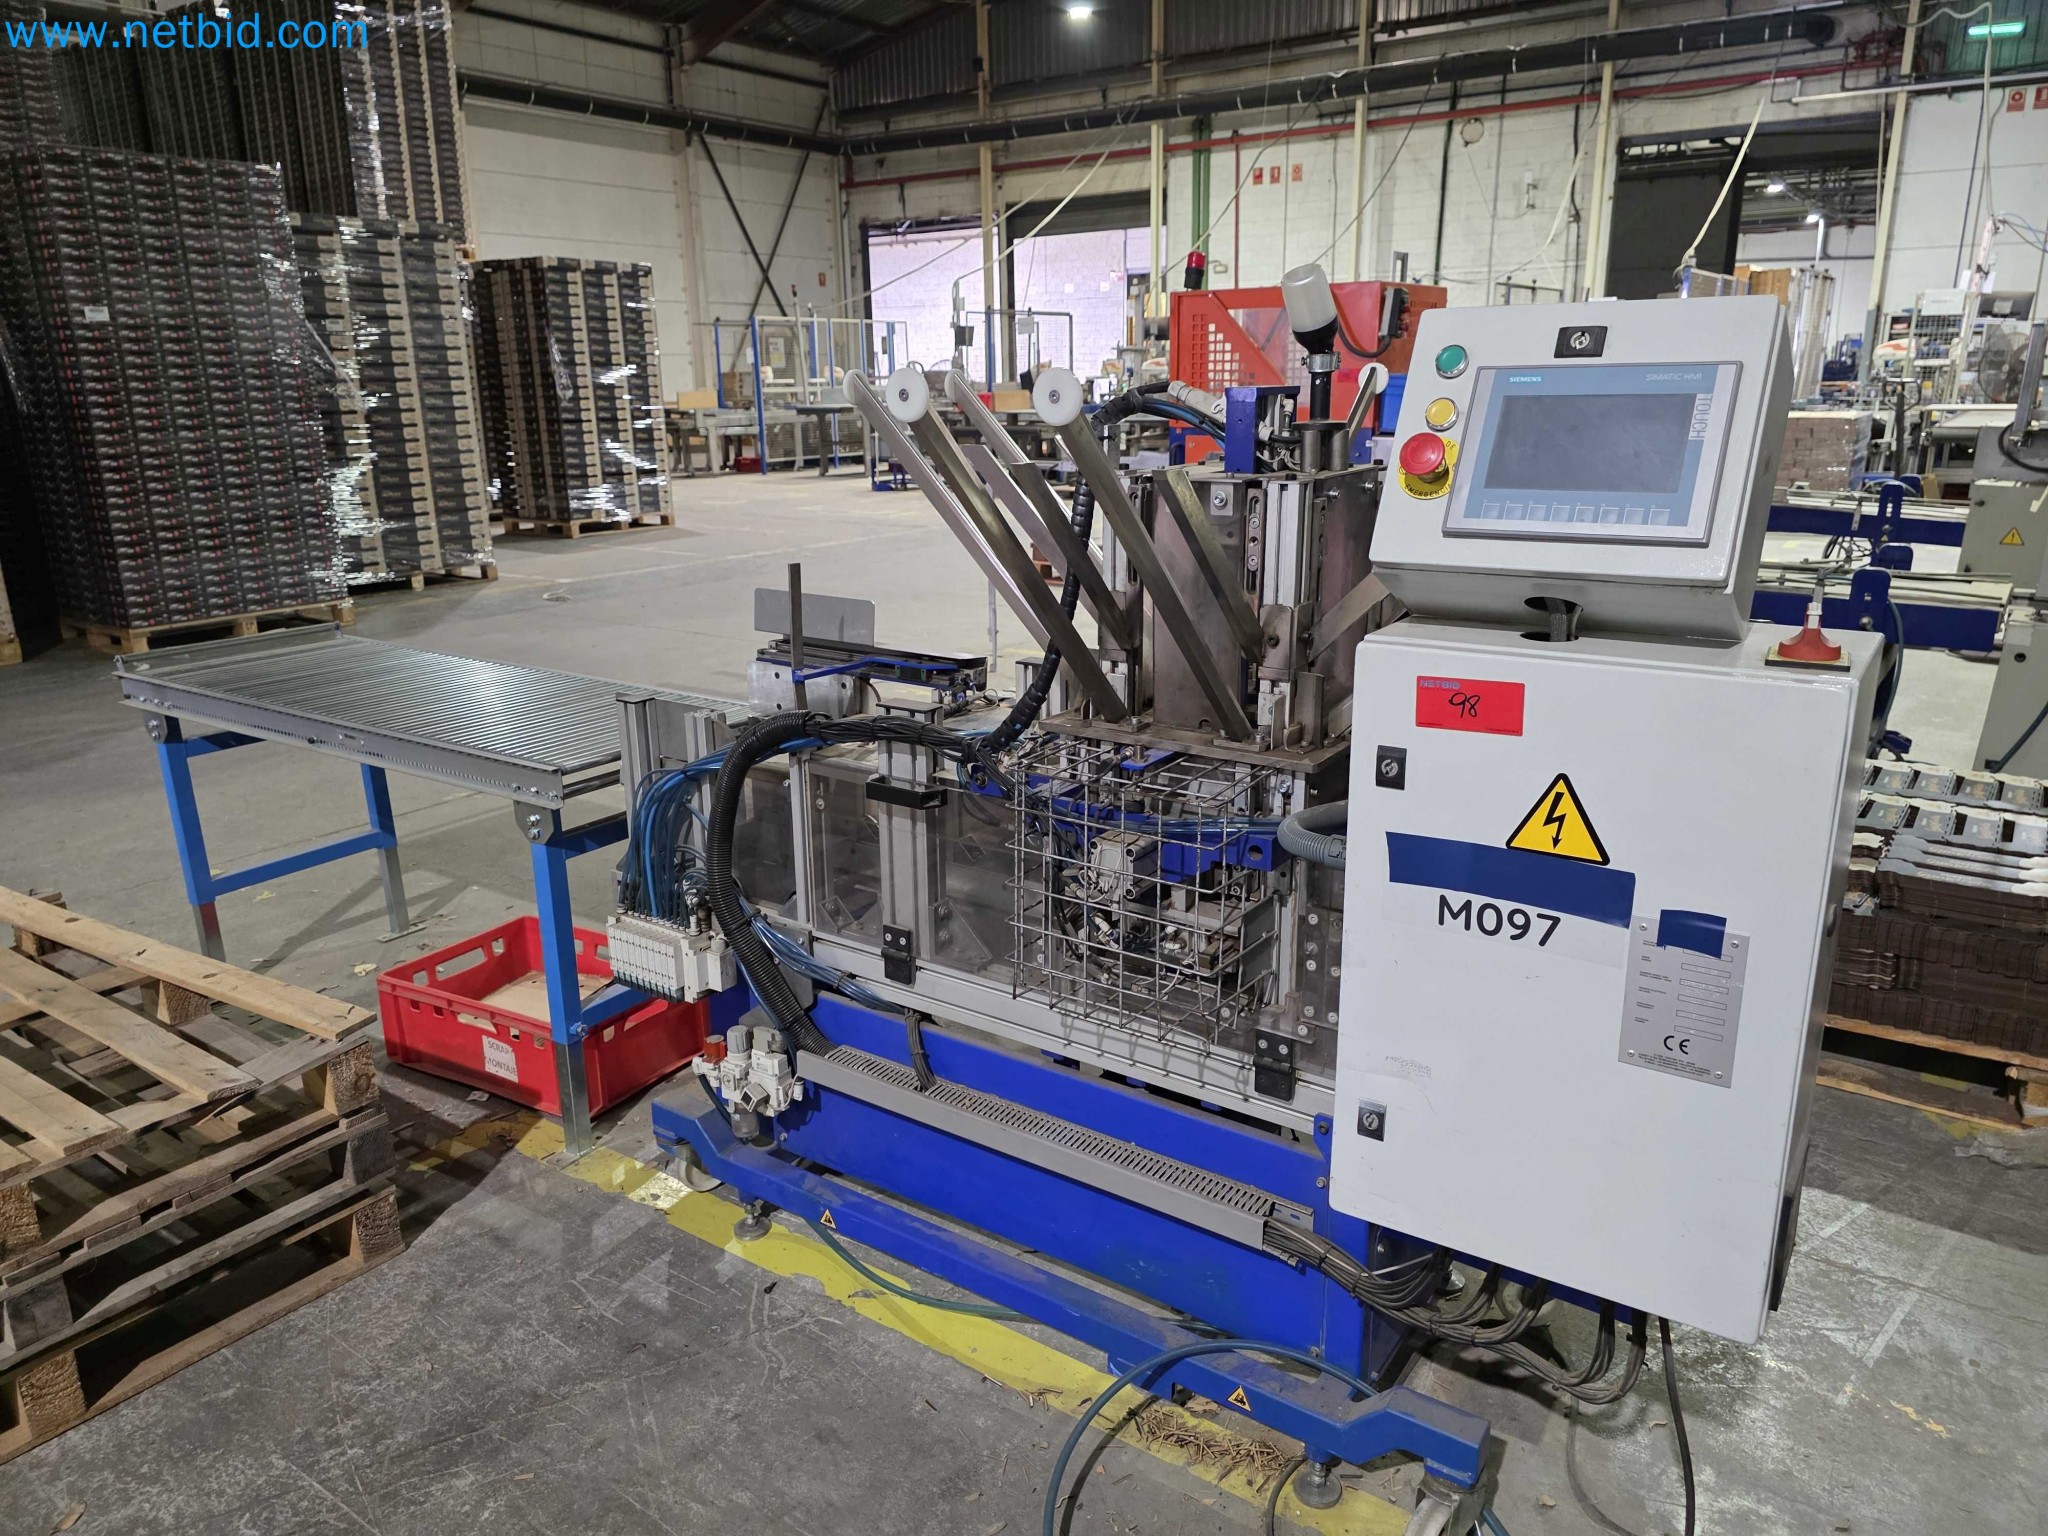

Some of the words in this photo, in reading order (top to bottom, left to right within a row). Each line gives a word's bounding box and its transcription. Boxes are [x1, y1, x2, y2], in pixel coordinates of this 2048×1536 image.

[1645, 373, 1682, 381] SIMATIC
[1690, 395, 1713, 438] TOUCH
[1445, 440, 1456, 451] DE
[1420, 680, 1461, 690] NETBID
[1448, 692, 1481, 718] 98
[1438, 894, 1561, 947] M097
